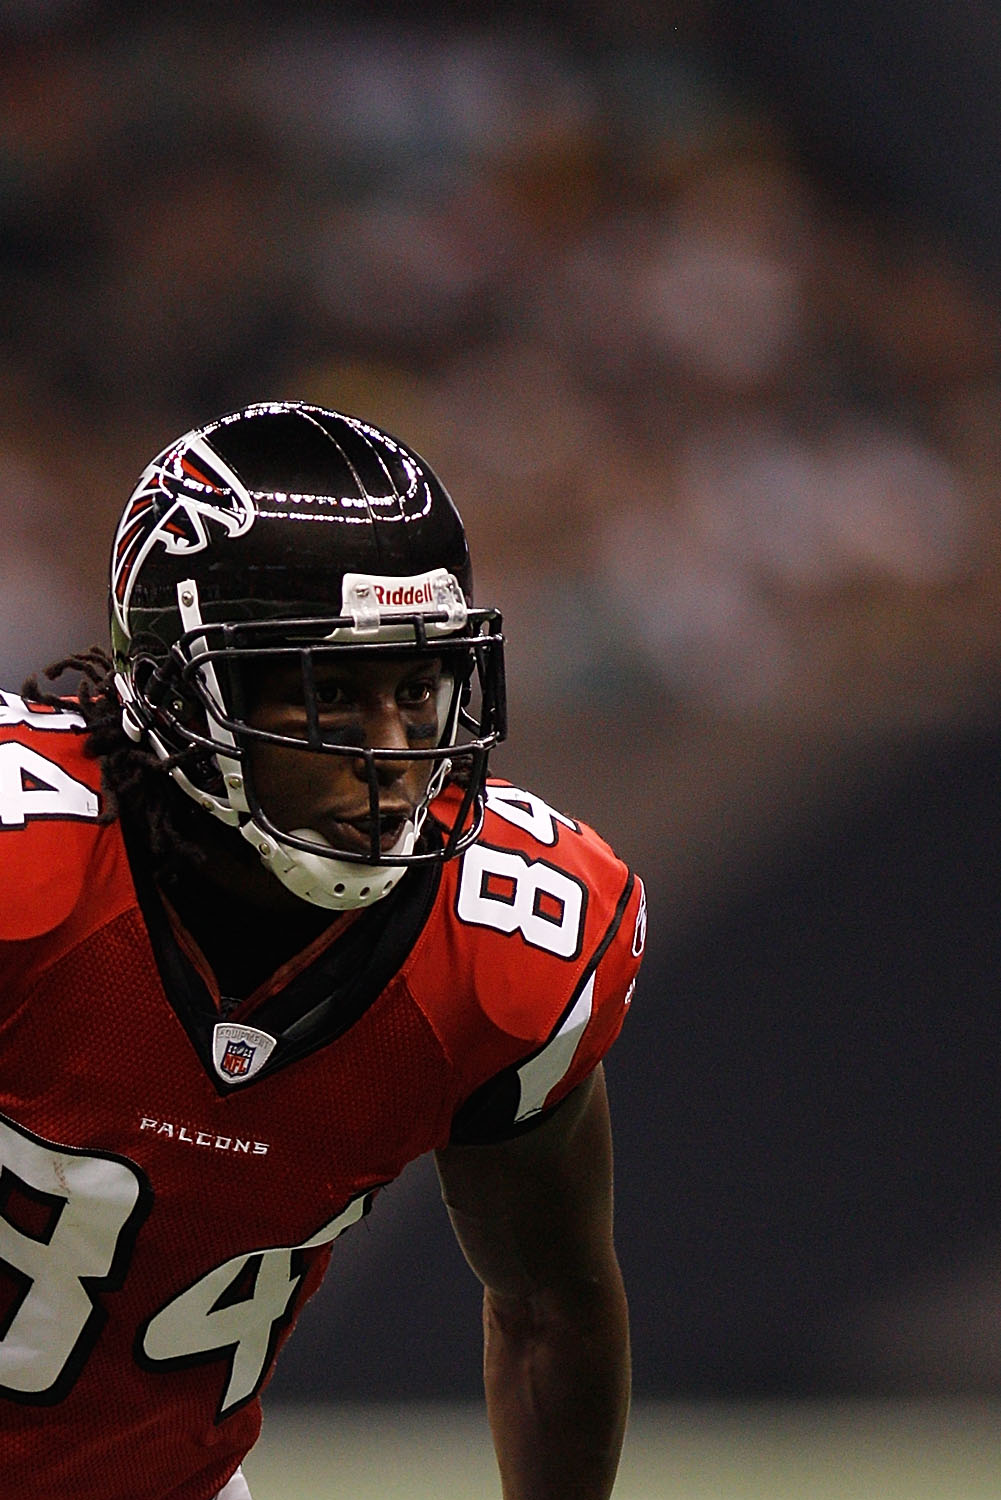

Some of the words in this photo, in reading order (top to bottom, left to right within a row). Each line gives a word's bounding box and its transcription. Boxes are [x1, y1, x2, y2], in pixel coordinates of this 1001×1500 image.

[373, 581, 433, 605] Riddell
[456, 784, 586, 961] 84
[223, 1053, 248, 1074] NFL
